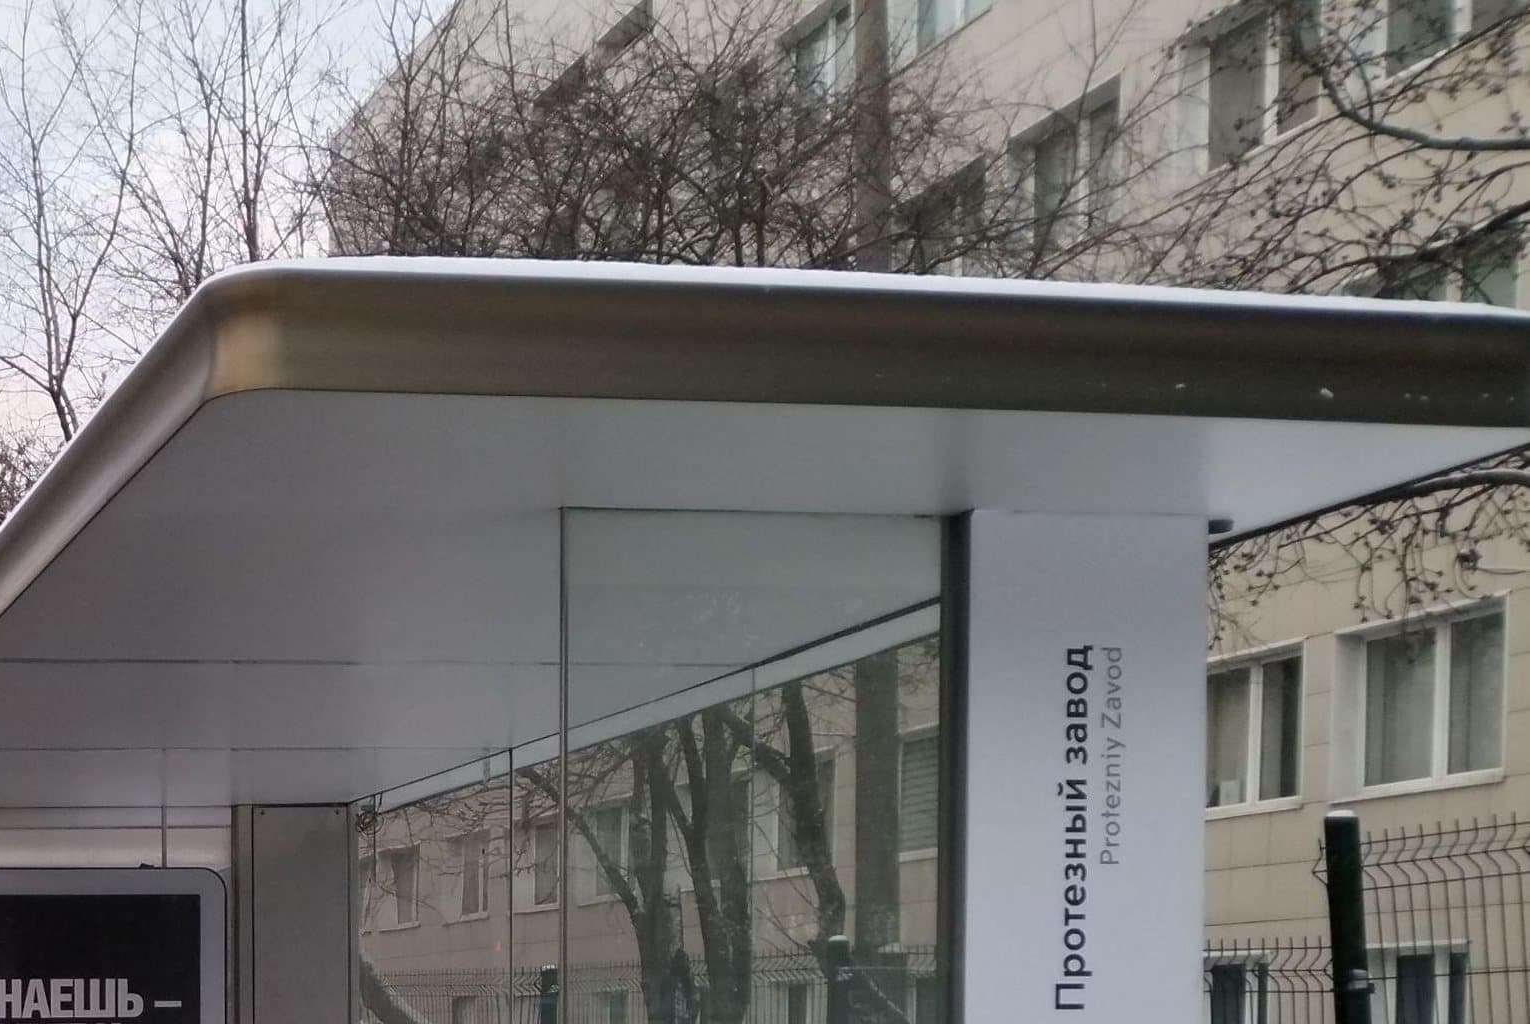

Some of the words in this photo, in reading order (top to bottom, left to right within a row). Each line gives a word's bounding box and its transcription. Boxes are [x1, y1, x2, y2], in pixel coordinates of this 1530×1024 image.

[1065, 644, 1094, 765] завод
[1100, 646, 1123, 729] Zavod
[1100, 738, 1127, 865] Protezniy
[1054, 779, 1093, 1011] Протезный
